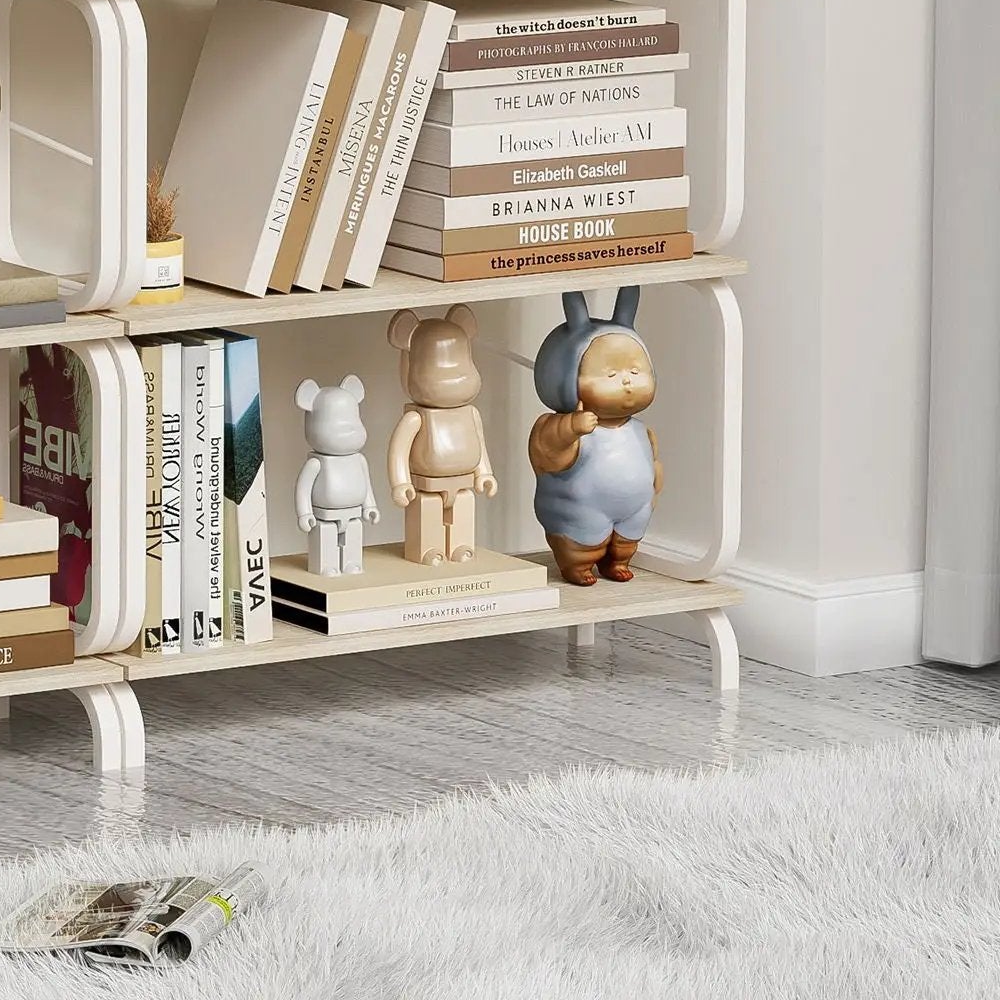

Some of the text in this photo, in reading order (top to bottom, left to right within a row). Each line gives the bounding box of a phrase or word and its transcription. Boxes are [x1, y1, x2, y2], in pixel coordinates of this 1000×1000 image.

[518, 14, 638, 35] witch burn
[478, 36, 658, 60] PHOTOGRAPHS FRANÇOIS HALARD
[516, 62, 624, 81] STEVEN RATNER
[400, 76, 428, 132] JUSTICE
[494, 86, 640, 110] THE LAW NATIONS
[344, 52, 407, 235] MERINGUES MACARONS
[500, 134, 553, 153] Houses
[300, 117, 334, 204] INSTANBUL
[513, 160, 627, 186] Elizabeth Gaskell
[492, 190, 636, 216] BRIANNA WIEST
[519, 218, 616, 245] HOUSE BOOK
[516, 241, 666, 271] princess saves herself
[406, 580, 491, 598] PERFECT IMPERFECT
[402, 603, 496, 622] EMMA BAXTER-WRIGHT
